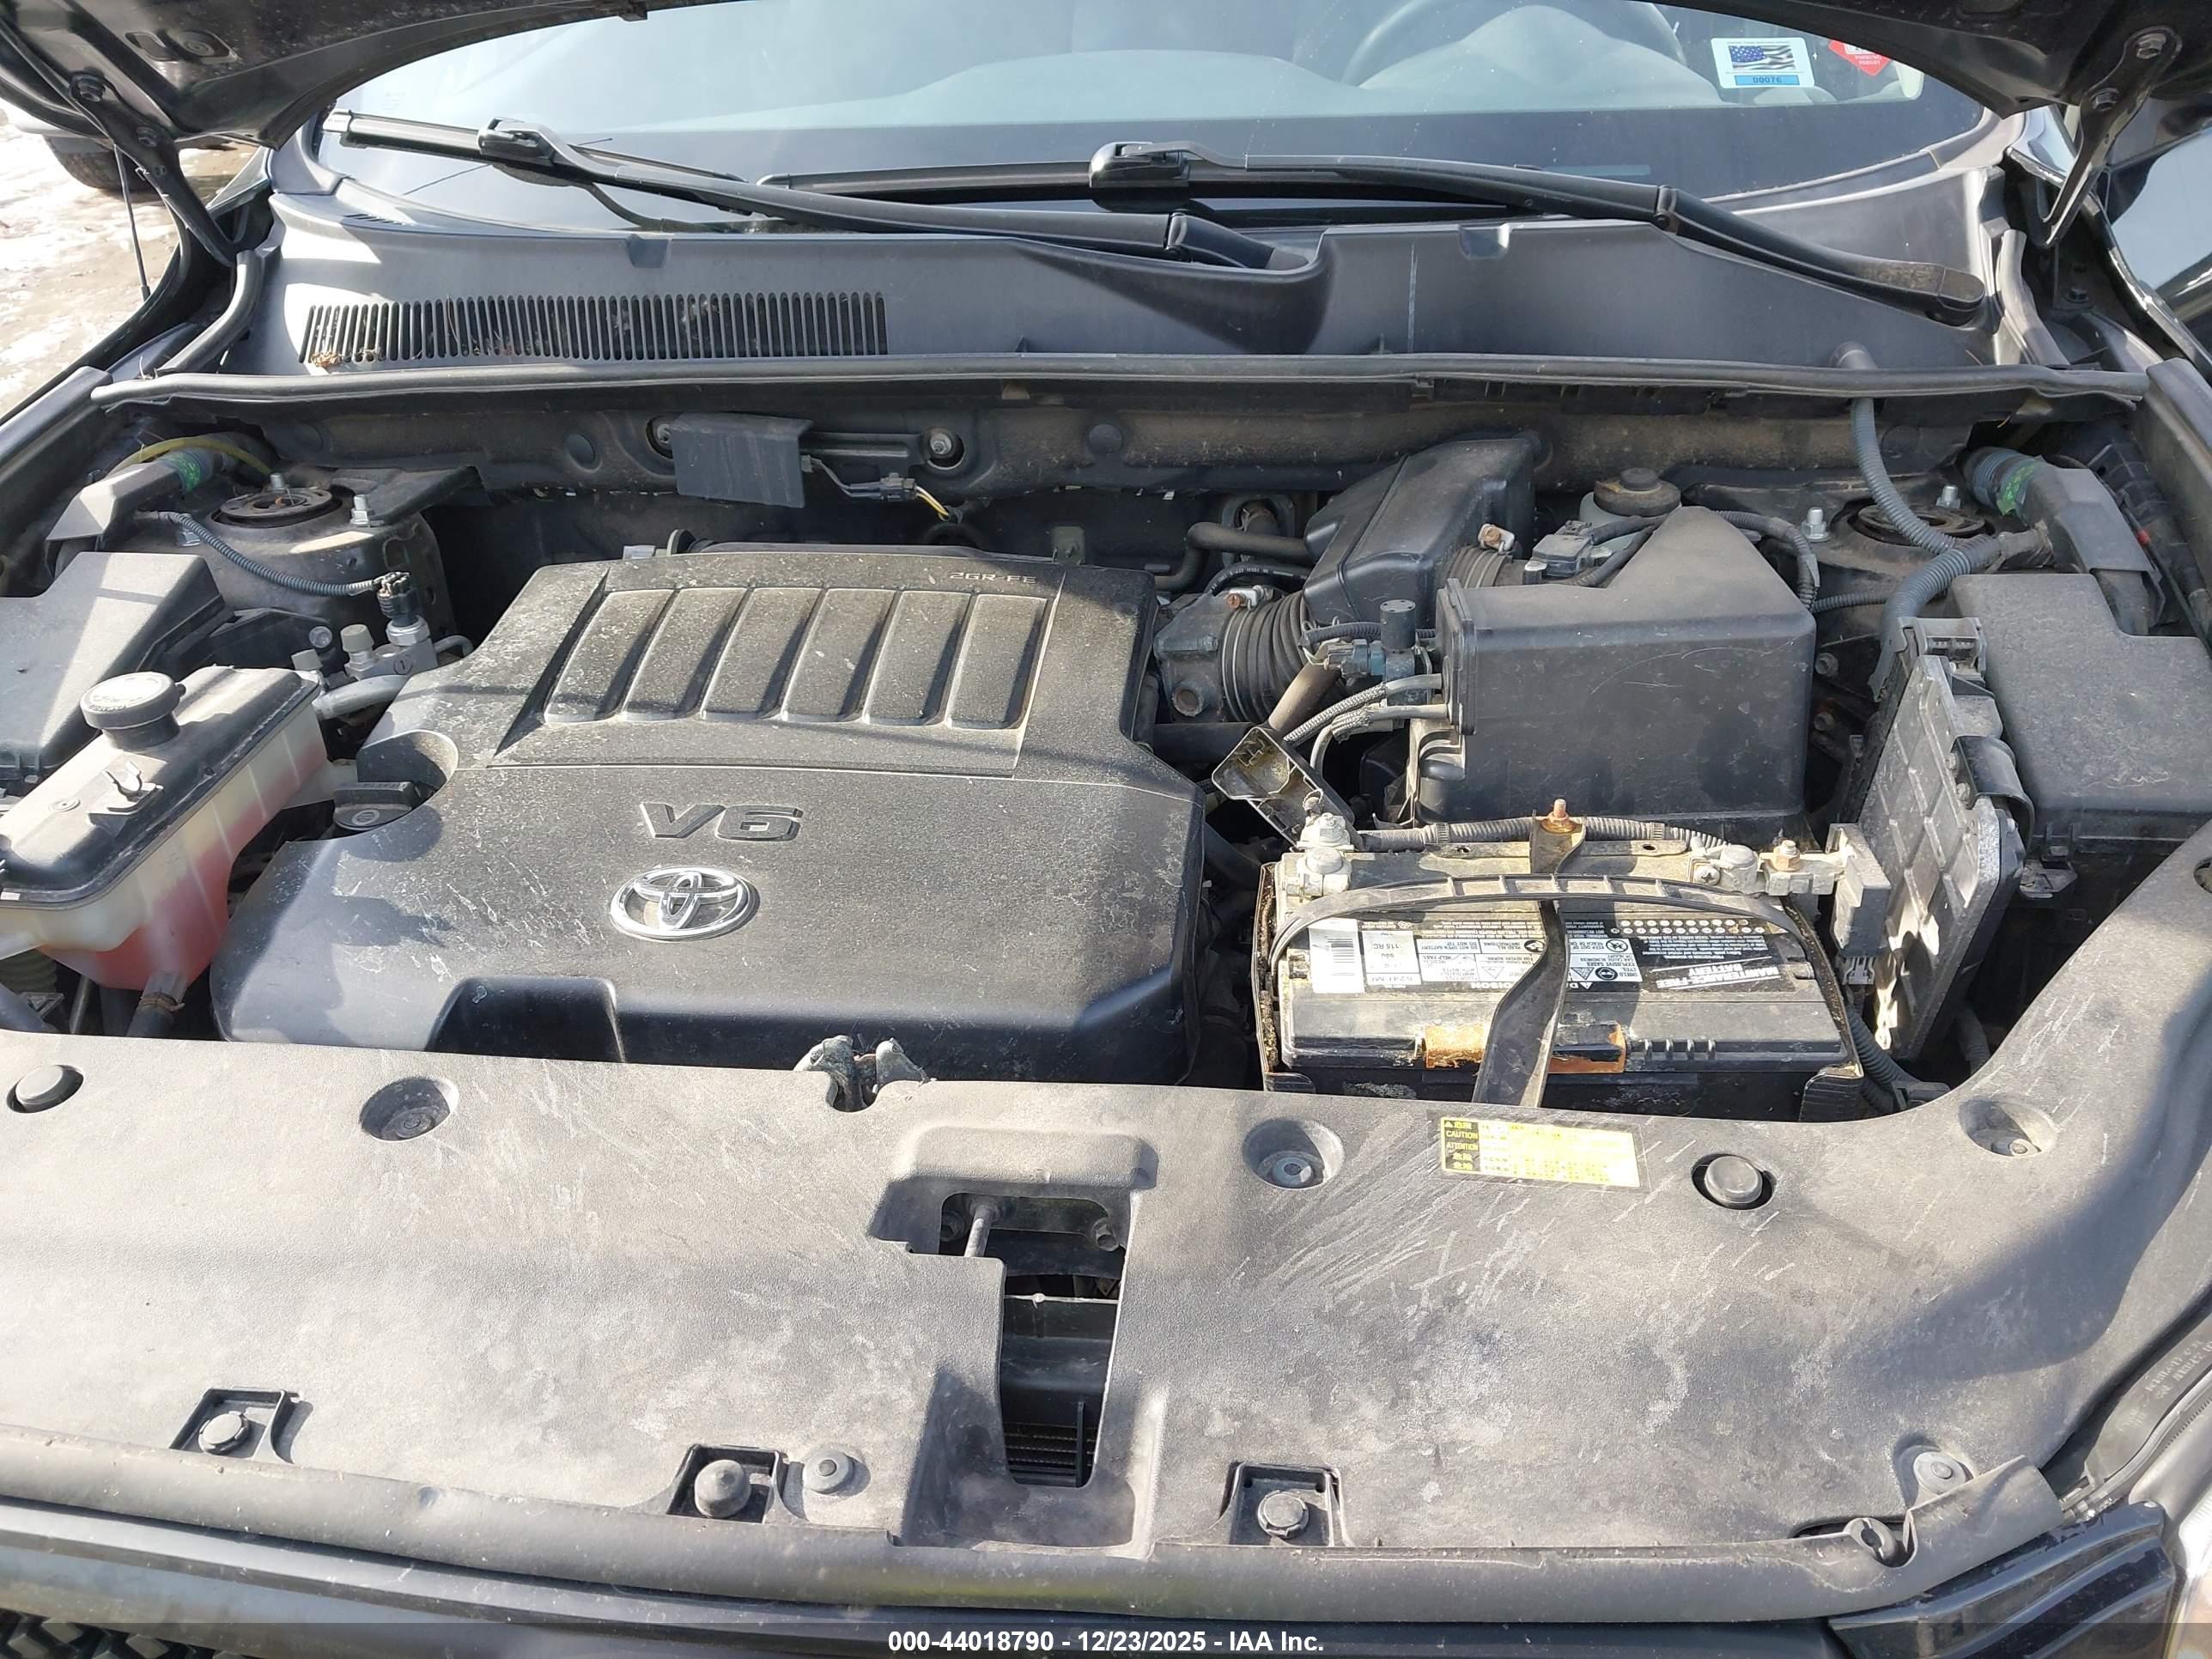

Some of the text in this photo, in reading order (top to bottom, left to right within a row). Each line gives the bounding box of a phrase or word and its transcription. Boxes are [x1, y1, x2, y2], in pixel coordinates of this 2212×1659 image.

[948, 571, 1037, 584] 2GR-FE
[639, 802, 805, 842] V6
[1688, 963, 1743, 976] BATTERY
[1446, 1130, 1479, 1139] CAUTION
[1446, 1142, 1478, 1151] ATTENTION
